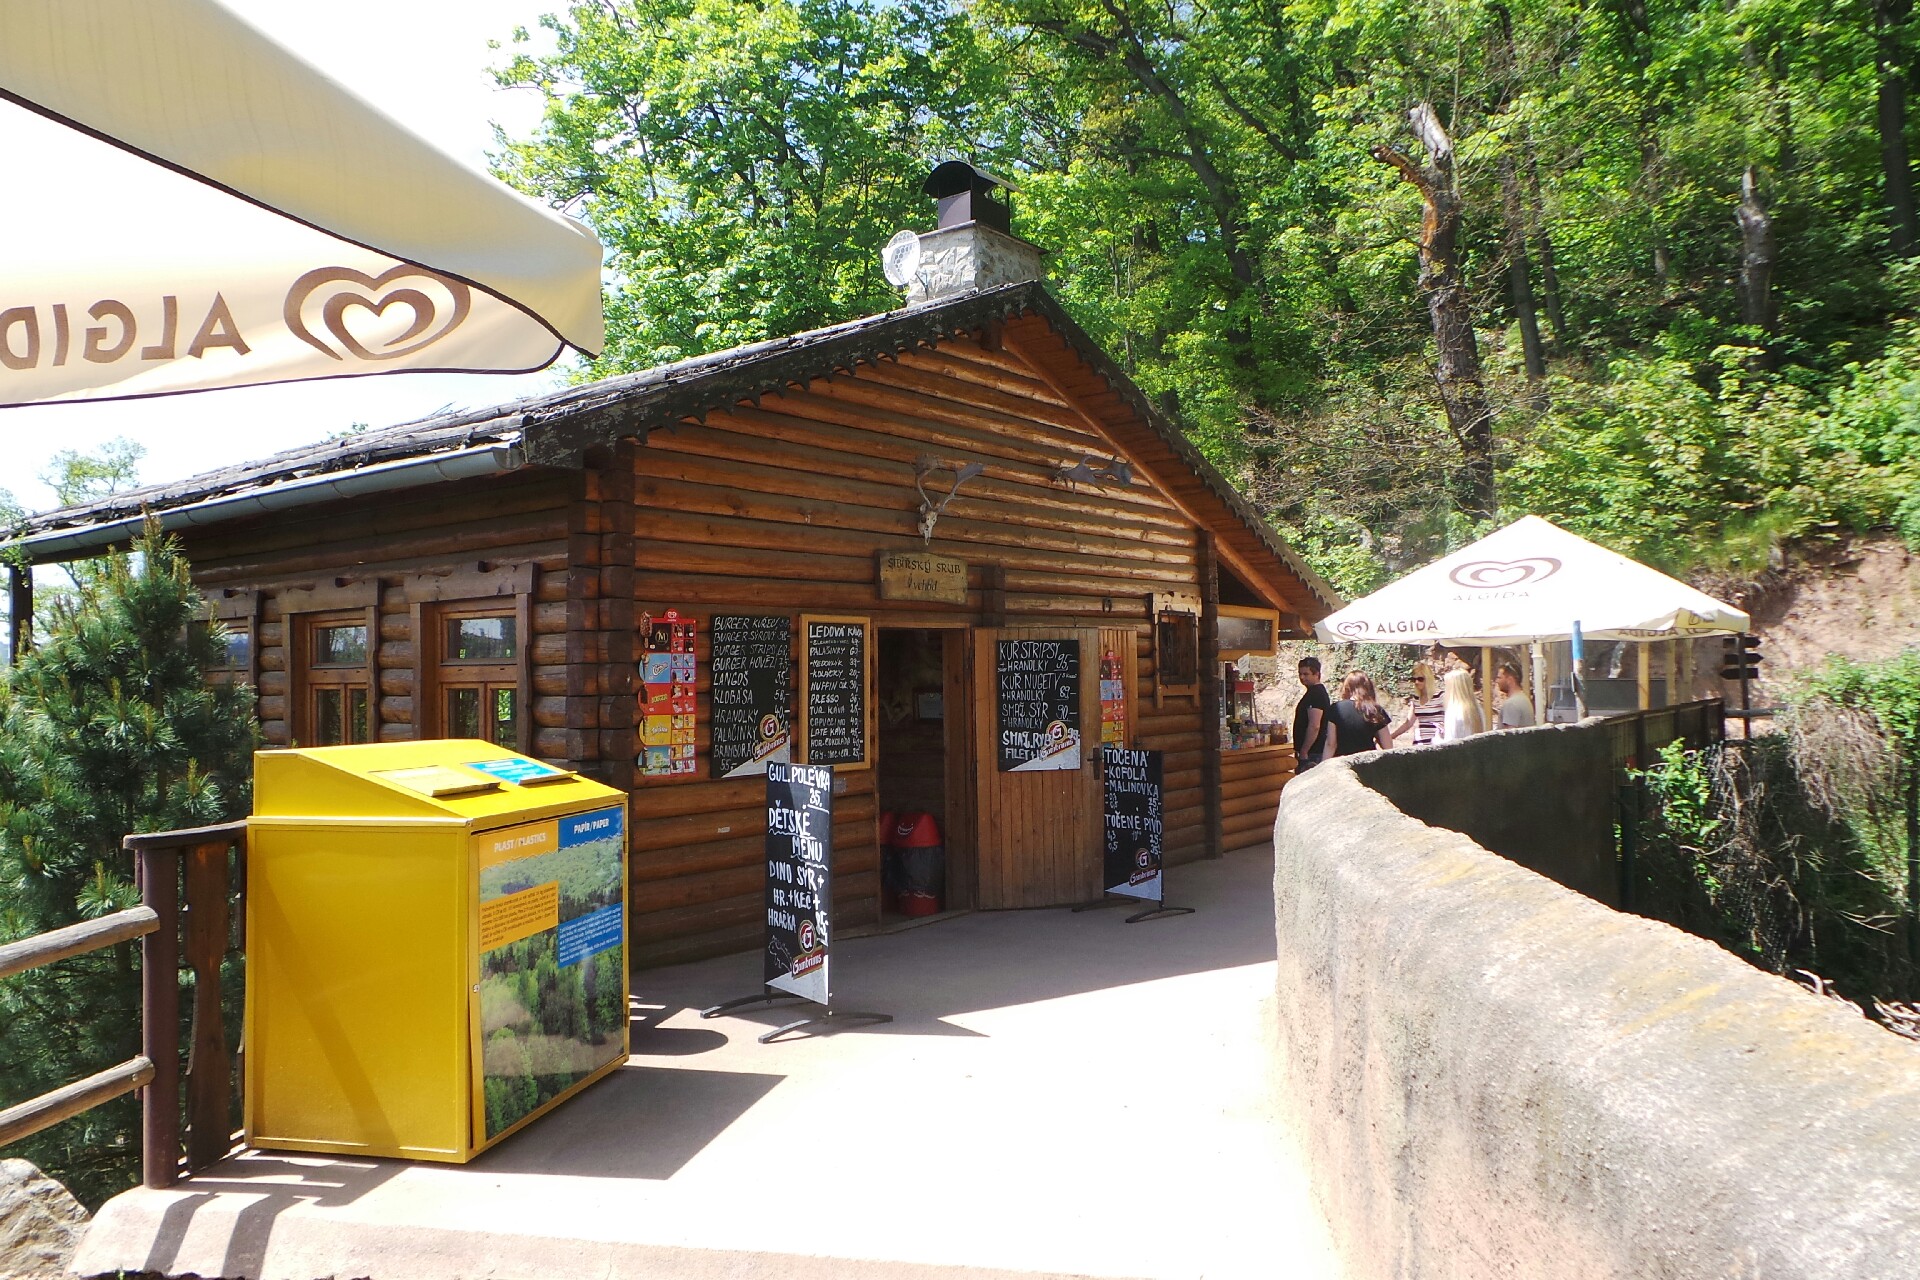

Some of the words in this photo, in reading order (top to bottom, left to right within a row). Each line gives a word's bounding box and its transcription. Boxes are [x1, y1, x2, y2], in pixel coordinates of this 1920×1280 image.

[714, 616, 750, 631] BURGER
[809, 625, 846, 638] LEDOVÁ
[1376, 619, 1438, 634] ALGIDA
[714, 631, 749, 645] BURGER
[713, 645, 746, 657] BURGER
[1020, 641, 1061, 659] STRIPSY
[713, 657, 747, 672] BURGER
[713, 670, 749, 687] LANGOŠ
[713, 687, 753, 705] KLOBÁSA
[810, 693, 840, 705] PRESSO
[714, 708, 759, 724] HRANOLKY
[713, 724, 758, 742] PALAČINKY
[768, 799, 811, 837] DĚTSKÉ
[1104, 807, 1141, 830] TOČENÉ
[1143, 817, 1162, 835] PIVO
[792, 836, 823, 862] MENU
[769, 860, 792, 884] DINO
[768, 907, 797, 933] HRAČKA
[792, 954, 822, 975] Gambrinus
